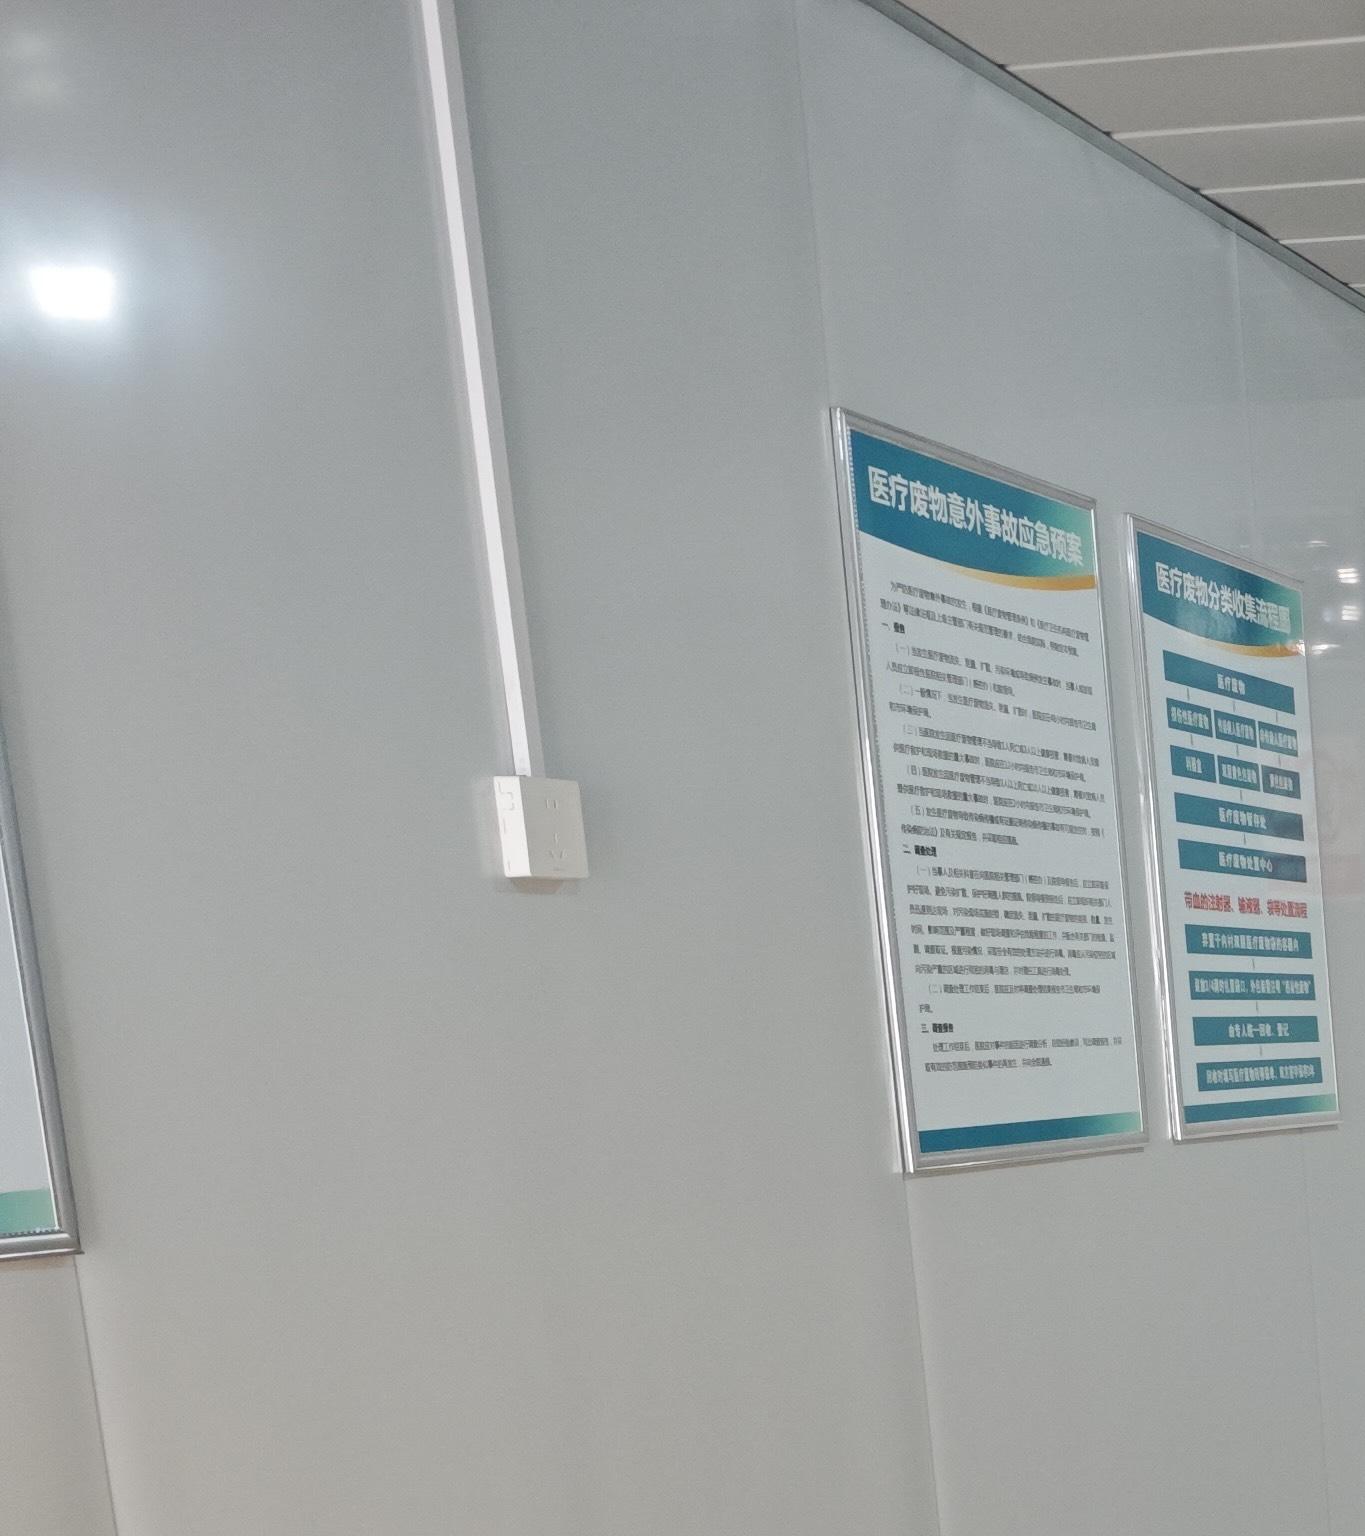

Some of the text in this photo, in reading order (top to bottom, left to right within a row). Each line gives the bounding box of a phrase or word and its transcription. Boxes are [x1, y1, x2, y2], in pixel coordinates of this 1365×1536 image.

[867, 465, 1084, 567] 医疗废物意外事故应急预案
[1155, 561, 1291, 634] 医疗废物分类收集流程图
